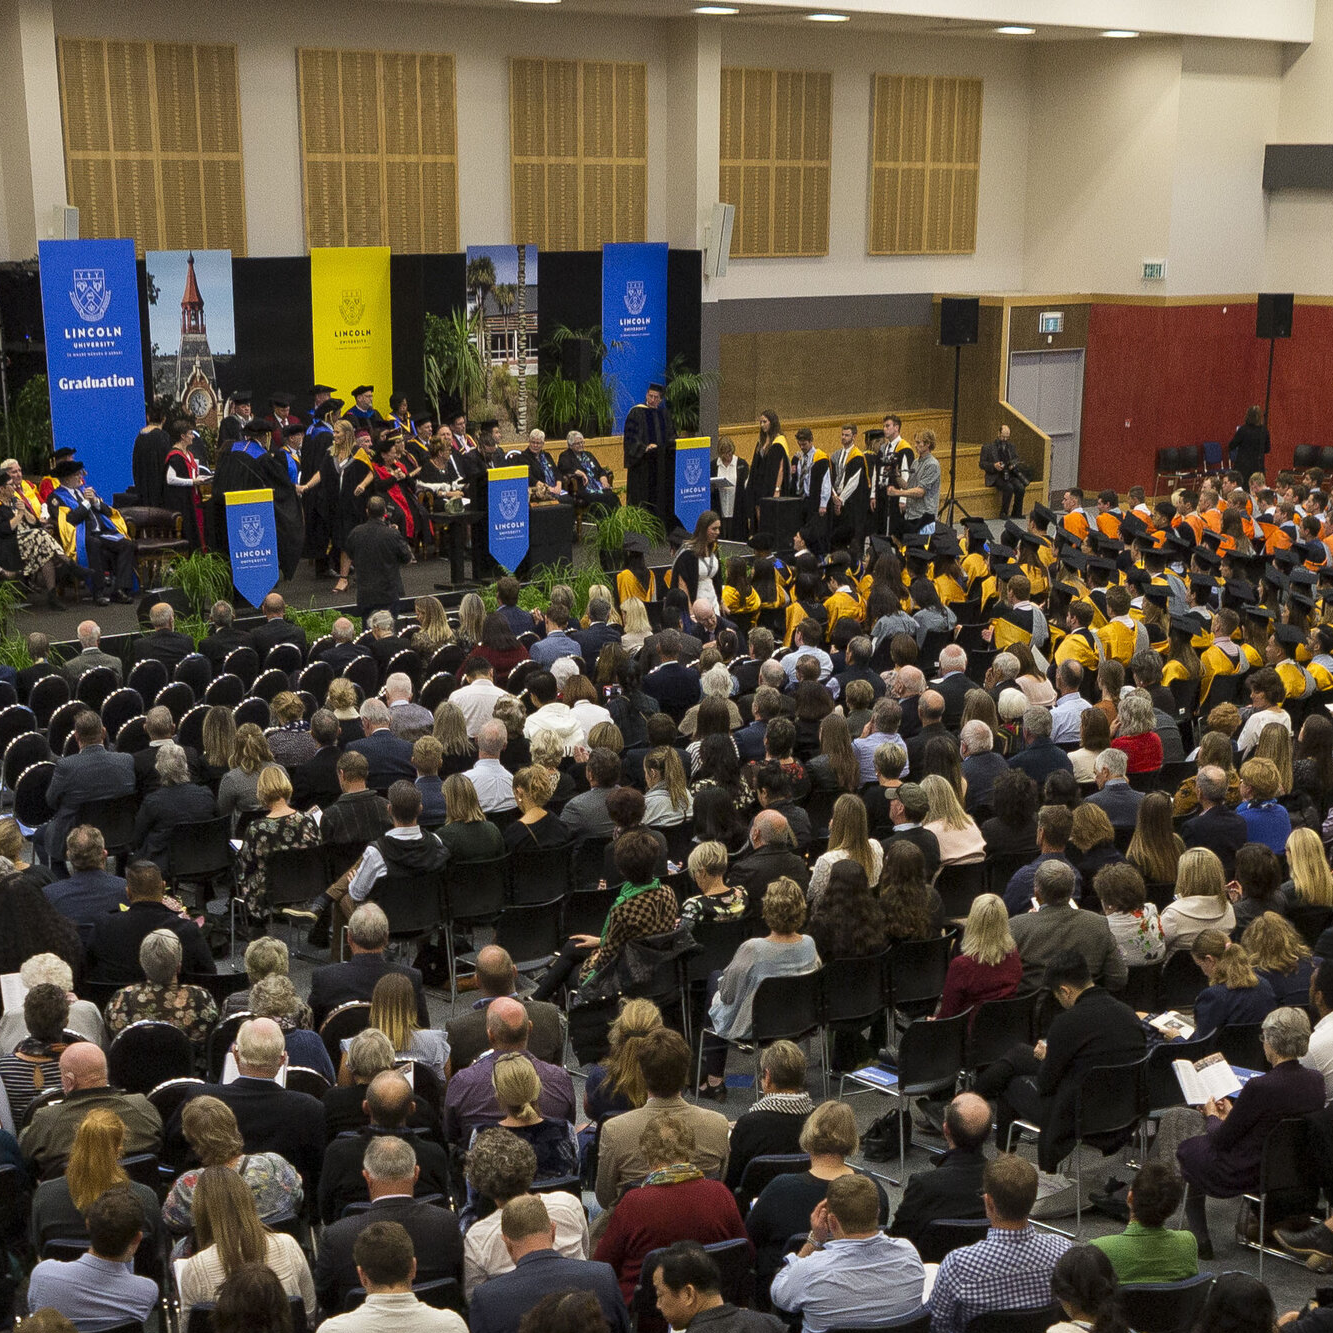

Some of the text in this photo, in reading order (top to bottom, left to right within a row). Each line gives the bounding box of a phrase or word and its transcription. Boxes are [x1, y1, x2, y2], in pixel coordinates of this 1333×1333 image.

[619, 317, 651, 325] LINCOLN
[64, 326, 122, 339] LINCOLN
[334, 329, 371, 337] LINCOLN
[73, 341, 115, 349] UNIVERSITY
[58, 373, 135, 391] Graduation
[494, 521, 525, 531] LINCOLN
[235, 549, 271, 558] LINCOLN
